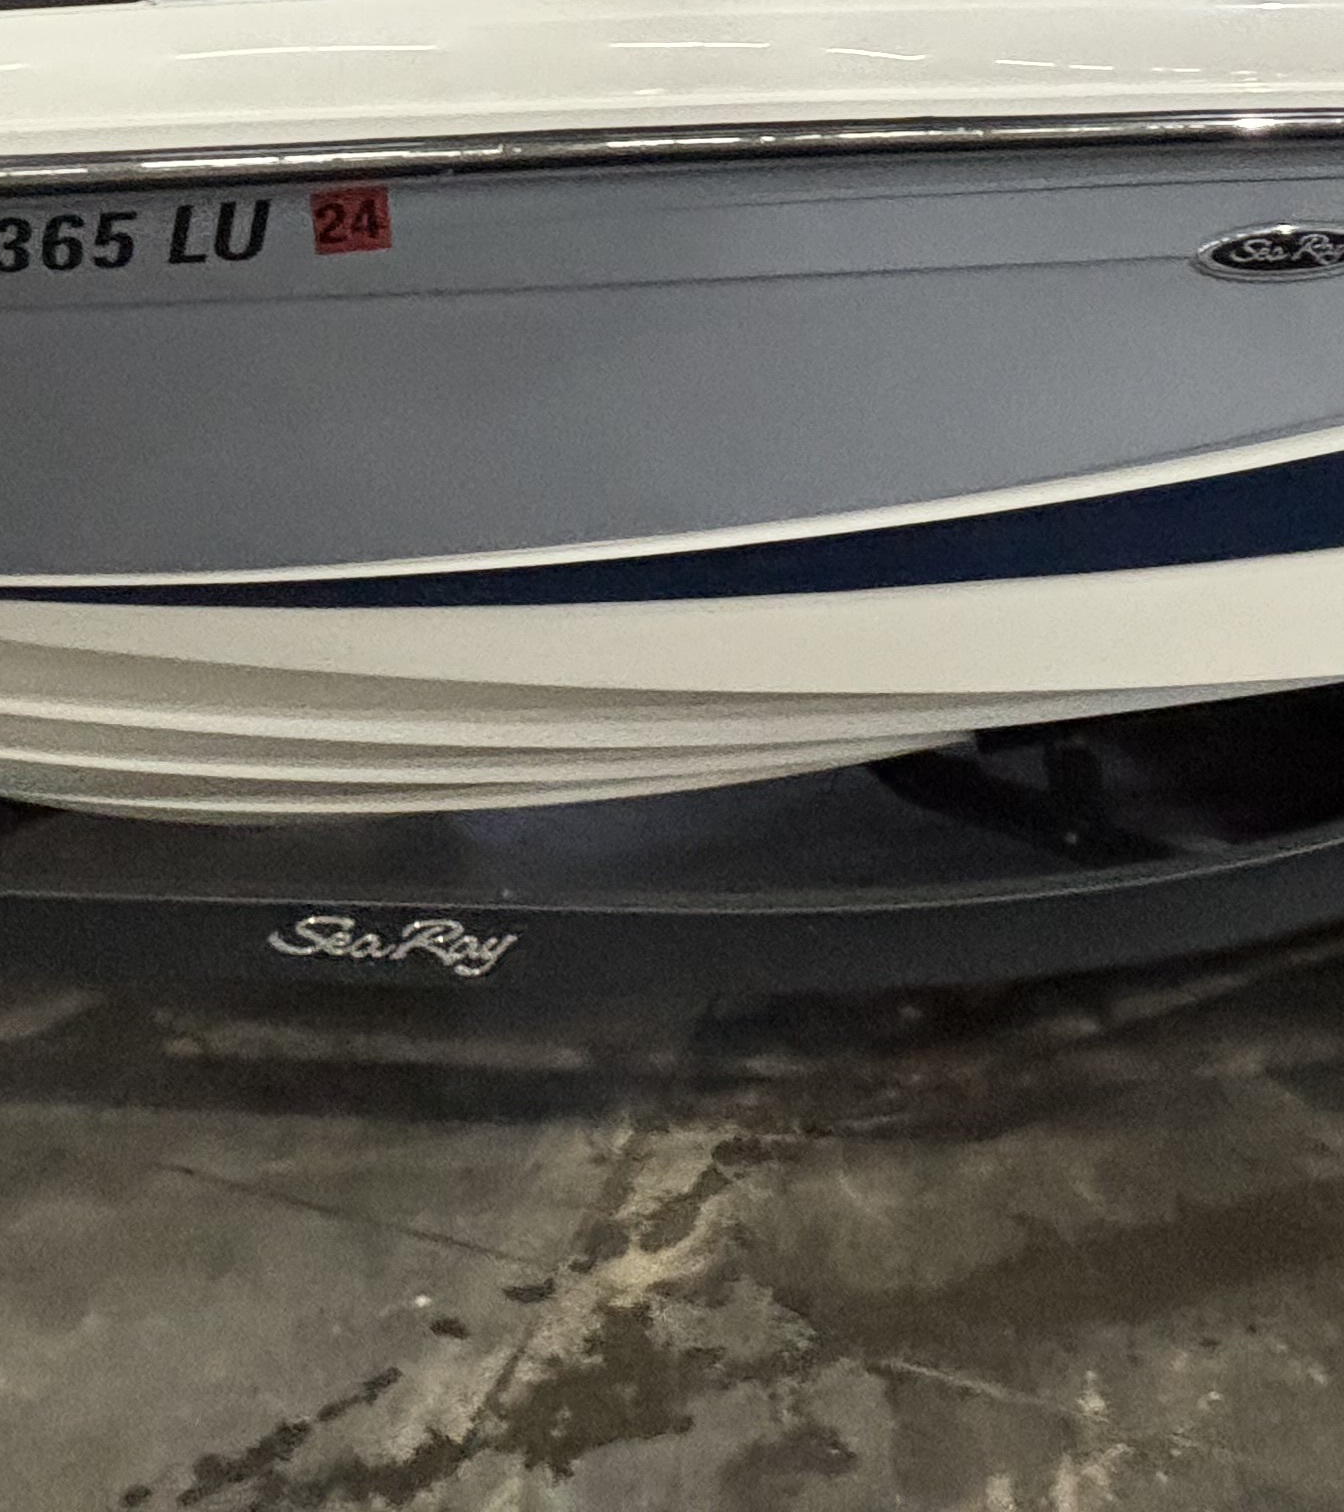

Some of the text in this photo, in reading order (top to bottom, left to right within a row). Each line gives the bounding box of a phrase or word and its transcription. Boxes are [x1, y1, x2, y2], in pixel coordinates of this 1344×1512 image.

[168, 198, 271, 265] LU
[316, 199, 379, 244] 24
[268, 915, 519, 977] Sea Ray
